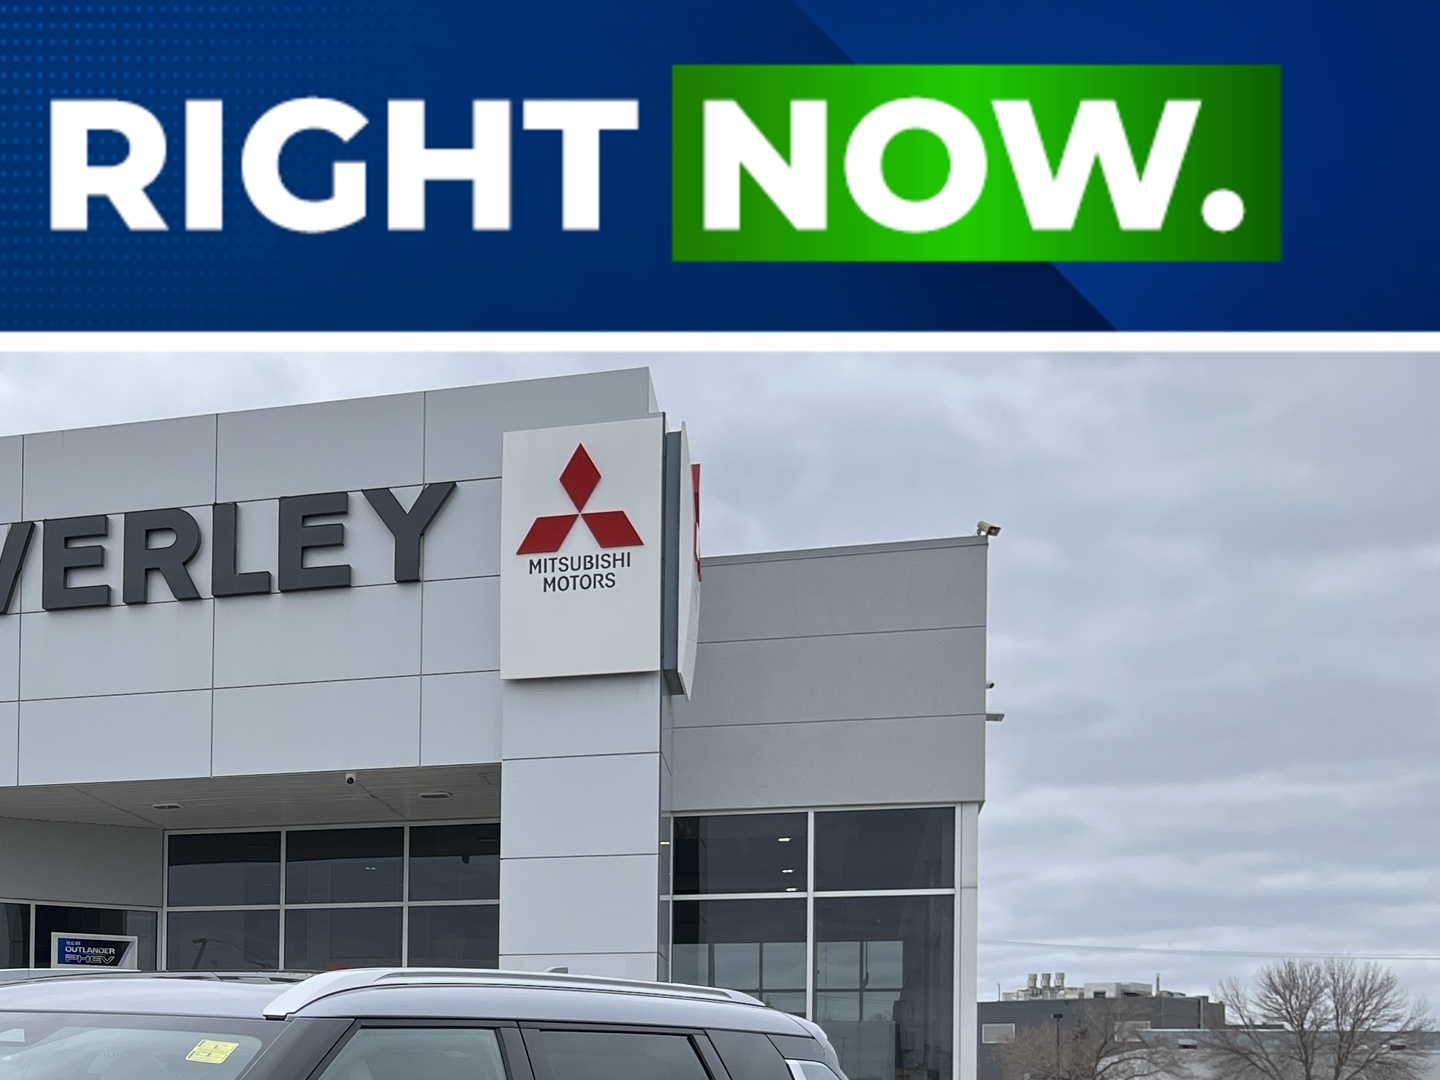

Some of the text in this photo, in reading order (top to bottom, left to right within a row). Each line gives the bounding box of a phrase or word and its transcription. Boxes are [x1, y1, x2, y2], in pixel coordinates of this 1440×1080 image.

[529, 552, 631, 574] MITSUBISHI
[543, 572, 617, 593] MOTORS
[65, 946, 116, 954] OUTLANDER
[65, 953, 116, 964] PHEV
